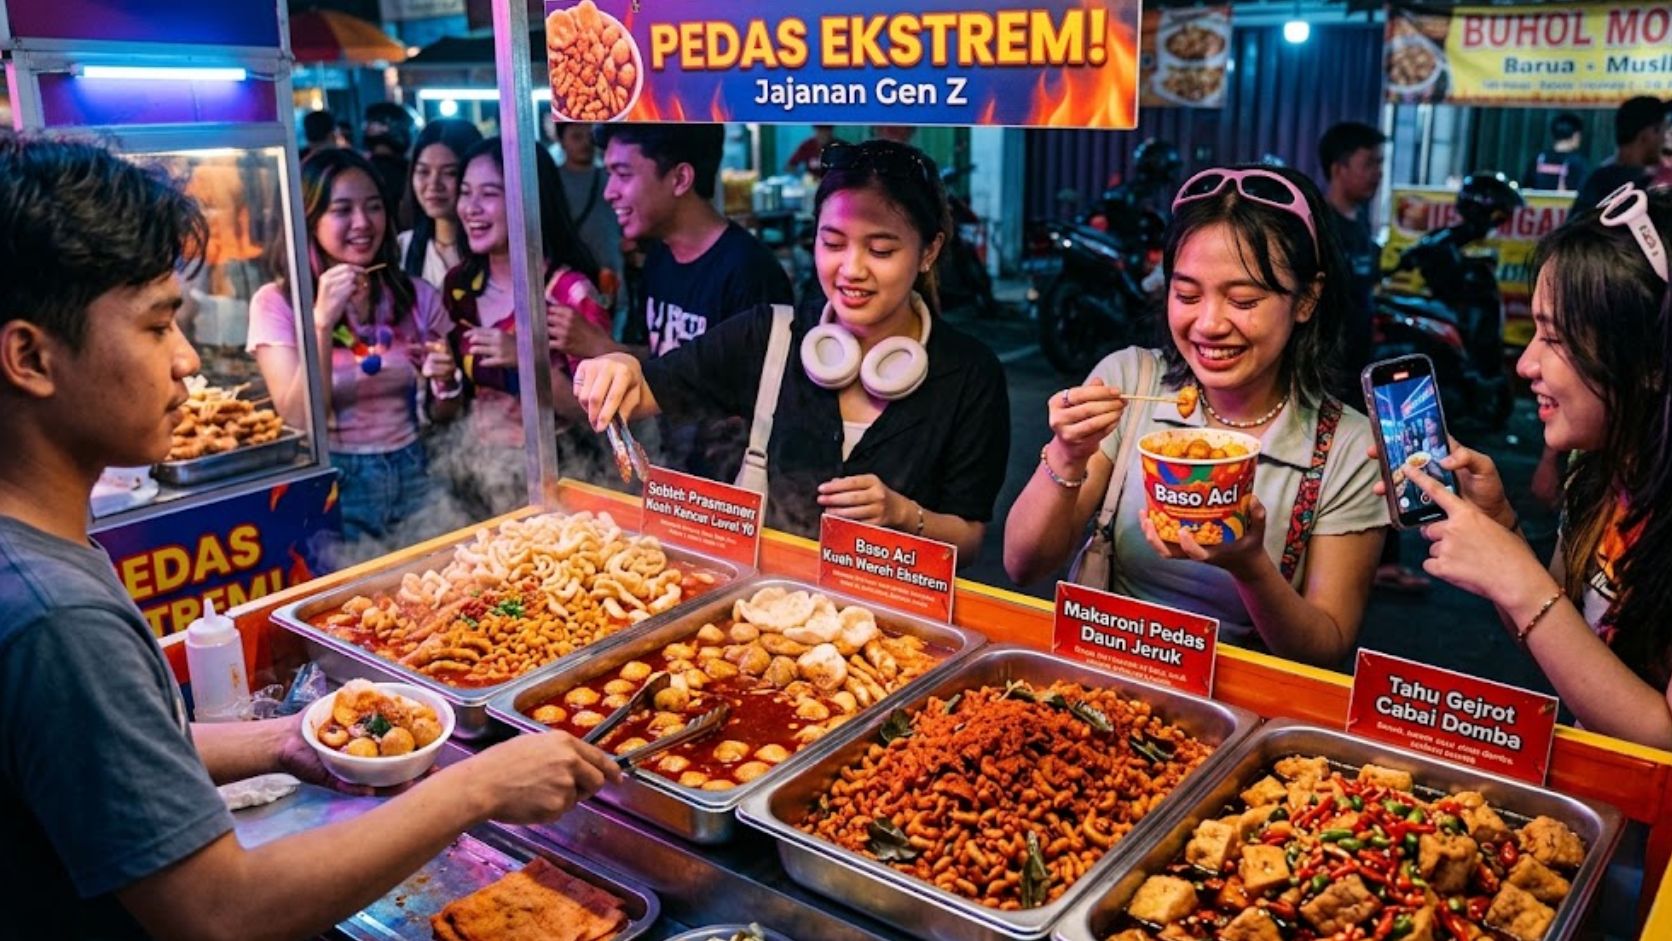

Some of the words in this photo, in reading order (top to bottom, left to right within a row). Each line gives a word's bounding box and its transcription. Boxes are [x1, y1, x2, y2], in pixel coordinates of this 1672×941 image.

[650, 18, 808, 69] PEDAS
[820, 9, 1108, 68] EKSTREM!
[1463, 11, 1592, 47] BUHOL
[1504, 57, 1575, 73] Barua
[755, 76, 866, 110] Jajanan
[876, 78, 937, 104] Gen
[946, 78, 968, 104] Z
[1155, 484, 1202, 506] Baso
[121, 524, 261, 600] EDAS
[855, 538, 890, 559] Baso
[143, 568, 284, 637] TREM!
[1063, 600, 1144, 635] Makaroni
[1149, 622, 1206, 651] Pedas
[1081, 626, 1127, 651] Daun
[1131, 639, 1182, 665] Jeruk
[1389, 675, 1440, 705] Tahu
[1446, 691, 1516, 724] Gejrot
[1375, 696, 1436, 726] Cabai
[1441, 713, 1521, 750] Domba
